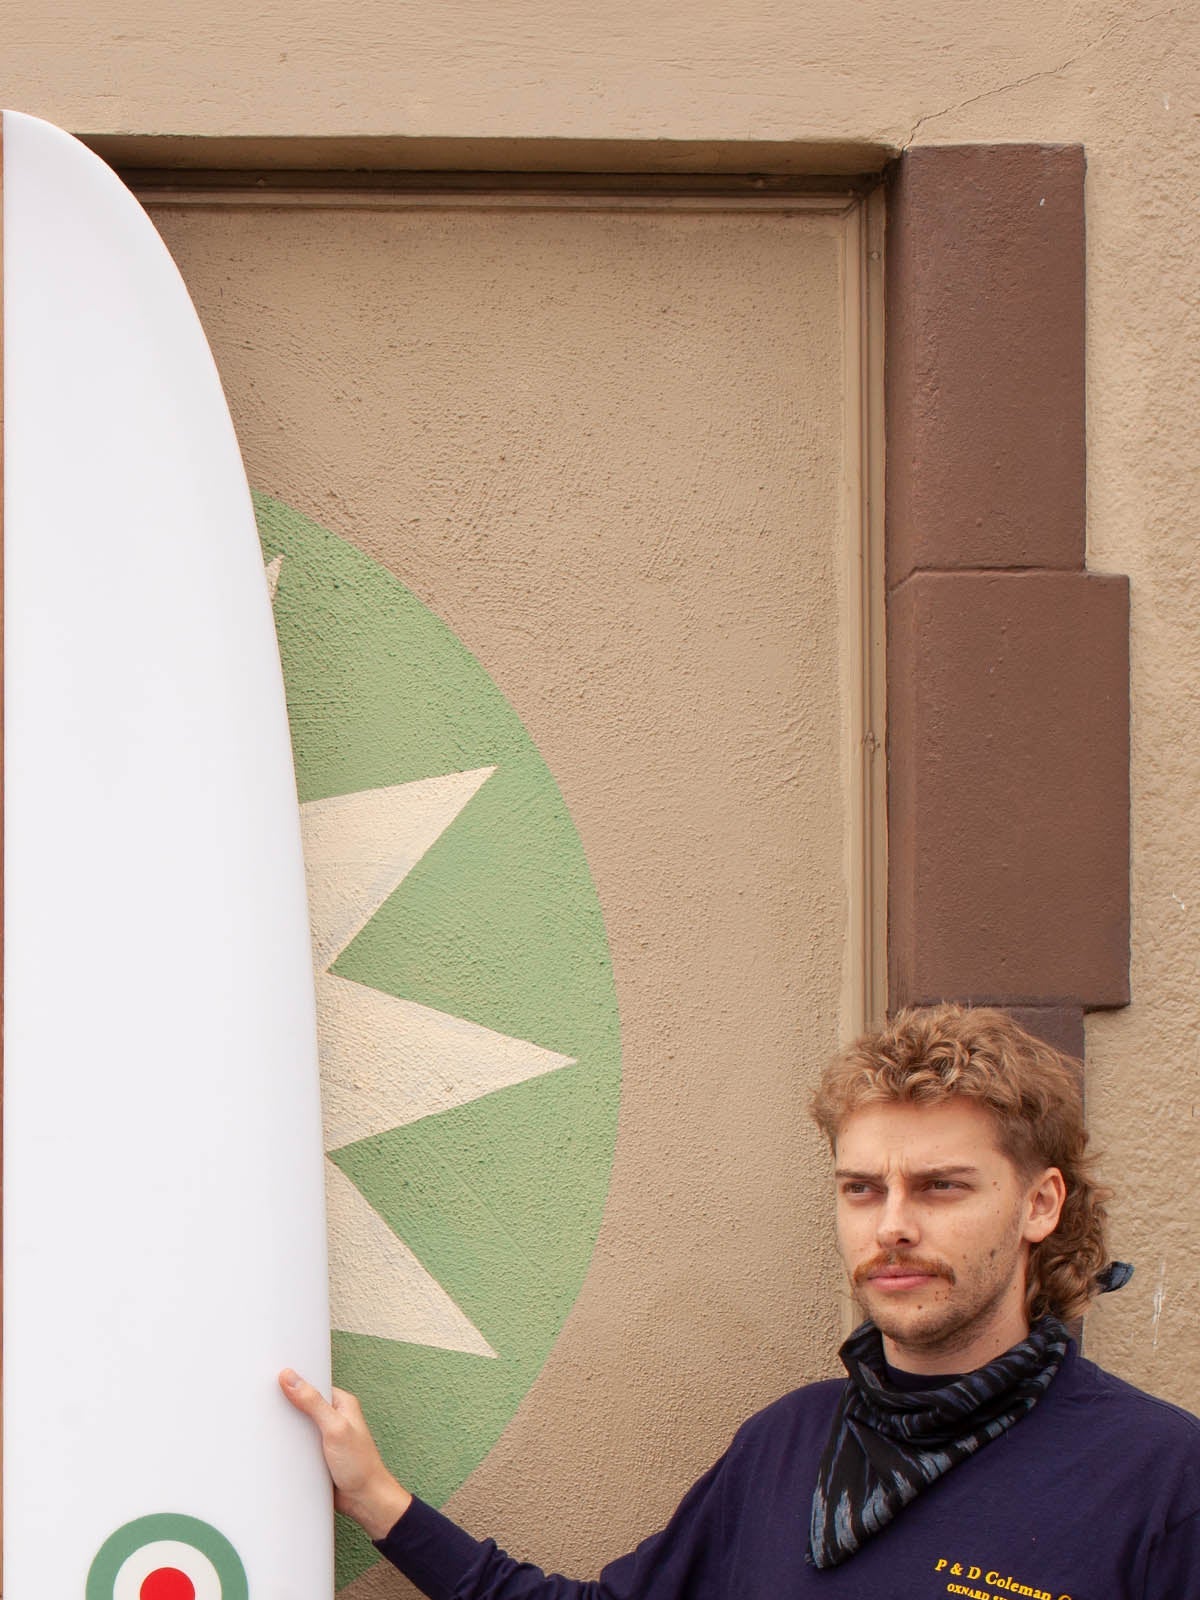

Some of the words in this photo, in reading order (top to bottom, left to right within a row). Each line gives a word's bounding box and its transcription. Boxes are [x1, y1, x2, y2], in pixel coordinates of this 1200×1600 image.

[935, 1558, 948, 1572] P
[950, 1563, 963, 1576] &
[966, 1566, 982, 1580] D
